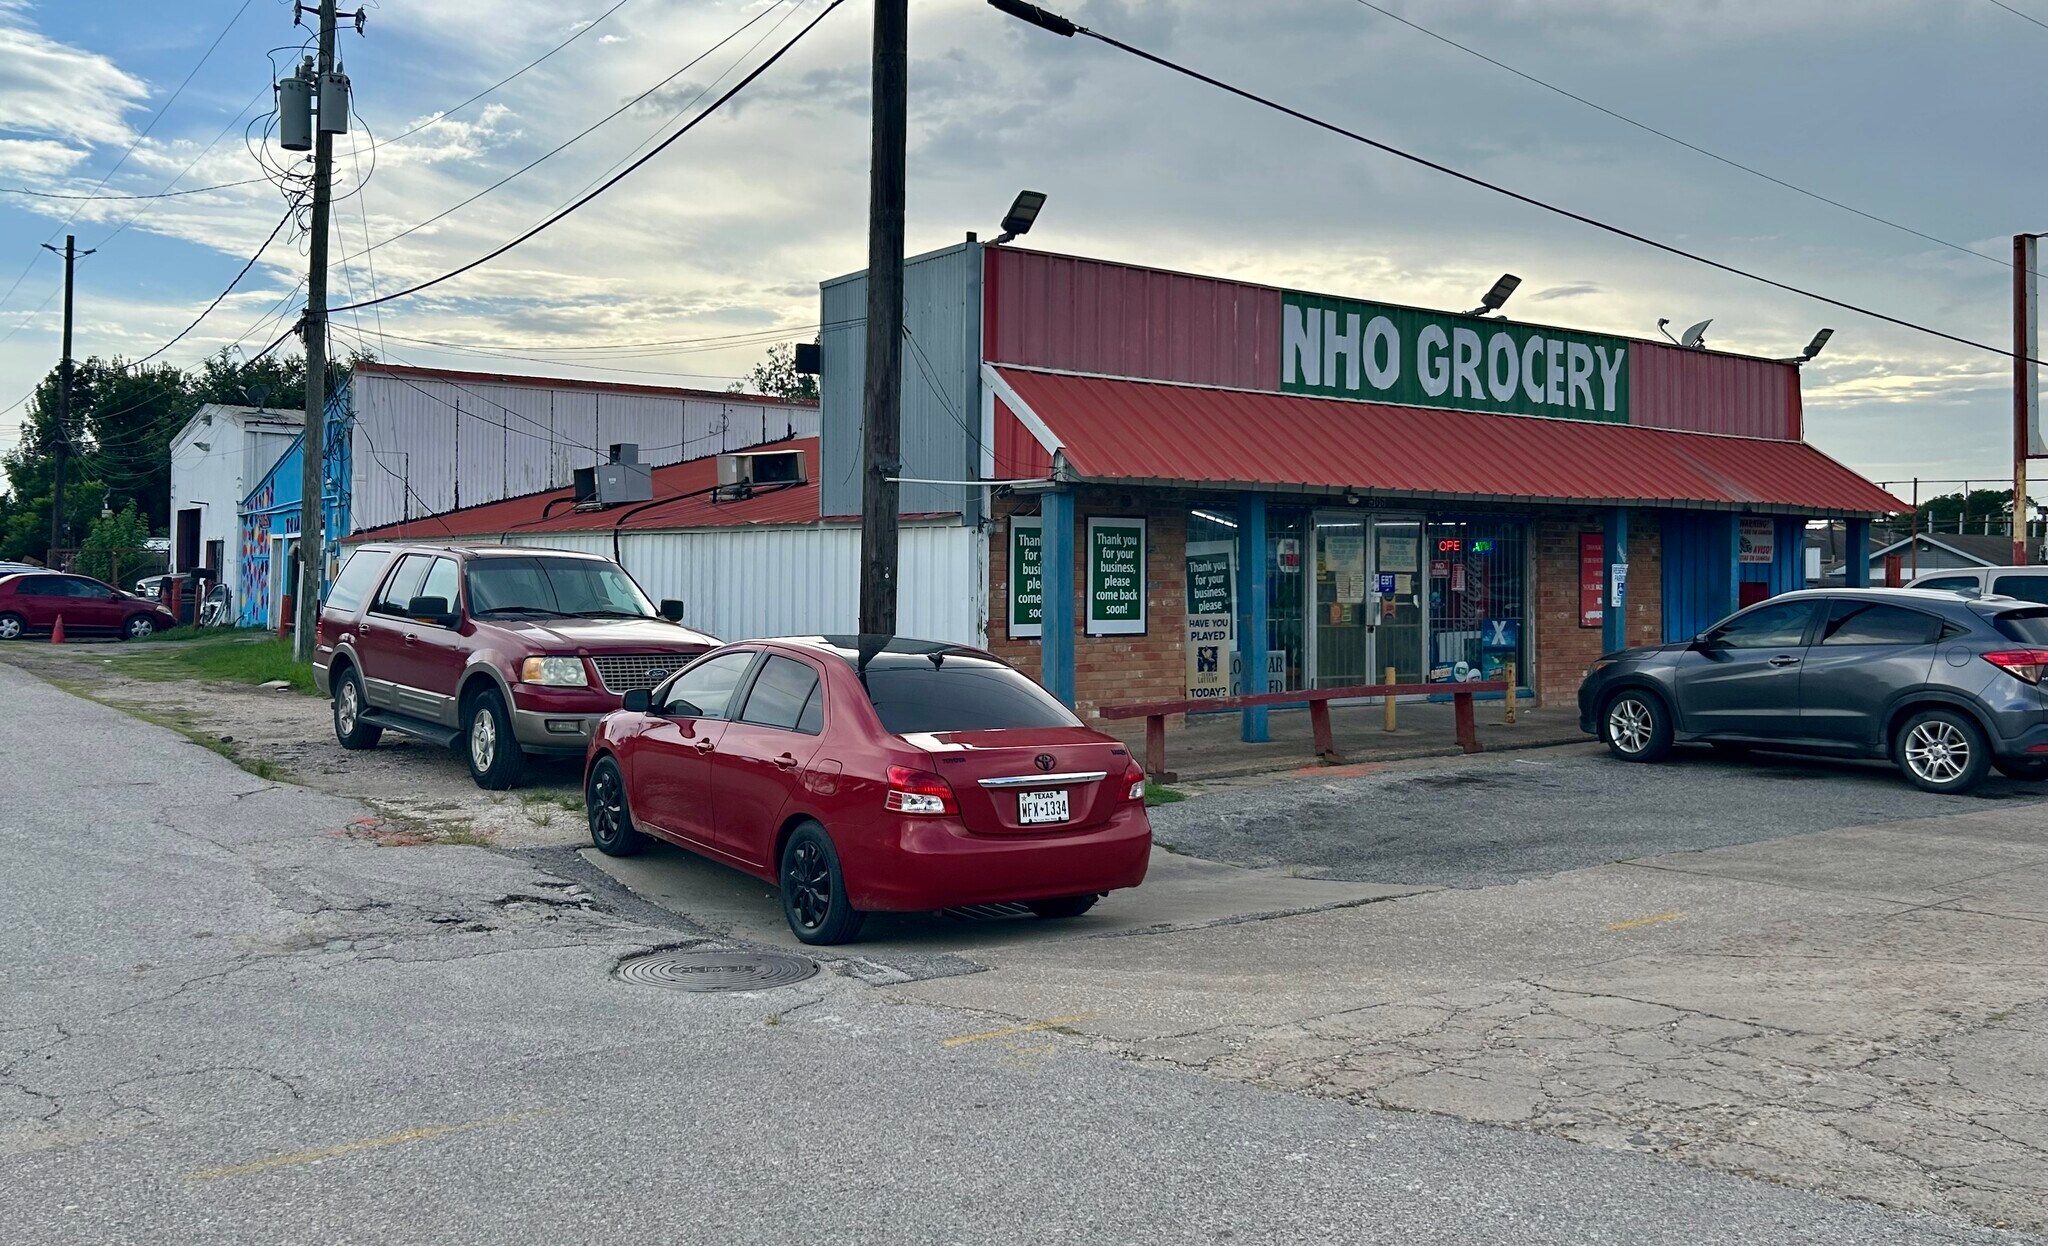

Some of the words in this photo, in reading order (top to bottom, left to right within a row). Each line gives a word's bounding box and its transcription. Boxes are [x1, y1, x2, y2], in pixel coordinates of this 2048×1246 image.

[1283, 304, 1400, 390] NHO
[1417, 324, 1625, 411] GROCERY
[1019, 534, 1042, 546] Than
[1097, 533, 1122, 545] Thank
[1123, 536, 1137, 548] you
[1024, 548, 1038, 560] for
[1102, 547, 1114, 558] for
[1116, 550, 1134, 561] your
[1100, 561, 1136, 574] business,
[1189, 560, 1212, 572] Thank
[1213, 562, 1226, 573] you
[1027, 577, 1041, 592] ple
[1104, 575, 1130, 589] please
[1195, 574, 1206, 585] for
[1208, 575, 1224, 587] your
[1381, 576, 1393, 585] EBT
[1096, 591, 1118, 600] come
[1120, 589, 1138, 600] back
[1194, 587, 1227, 598] business,
[1018, 594, 1042, 604] come
[1106, 602, 1128, 614] soon!
[1198, 600, 1222, 614] please
[1189, 619, 1209, 628] HAVE
[1212, 619, 1228, 627] YOU
[1191, 631, 1225, 641] PLAYED
[1190, 687, 1227, 697] TODAY?
